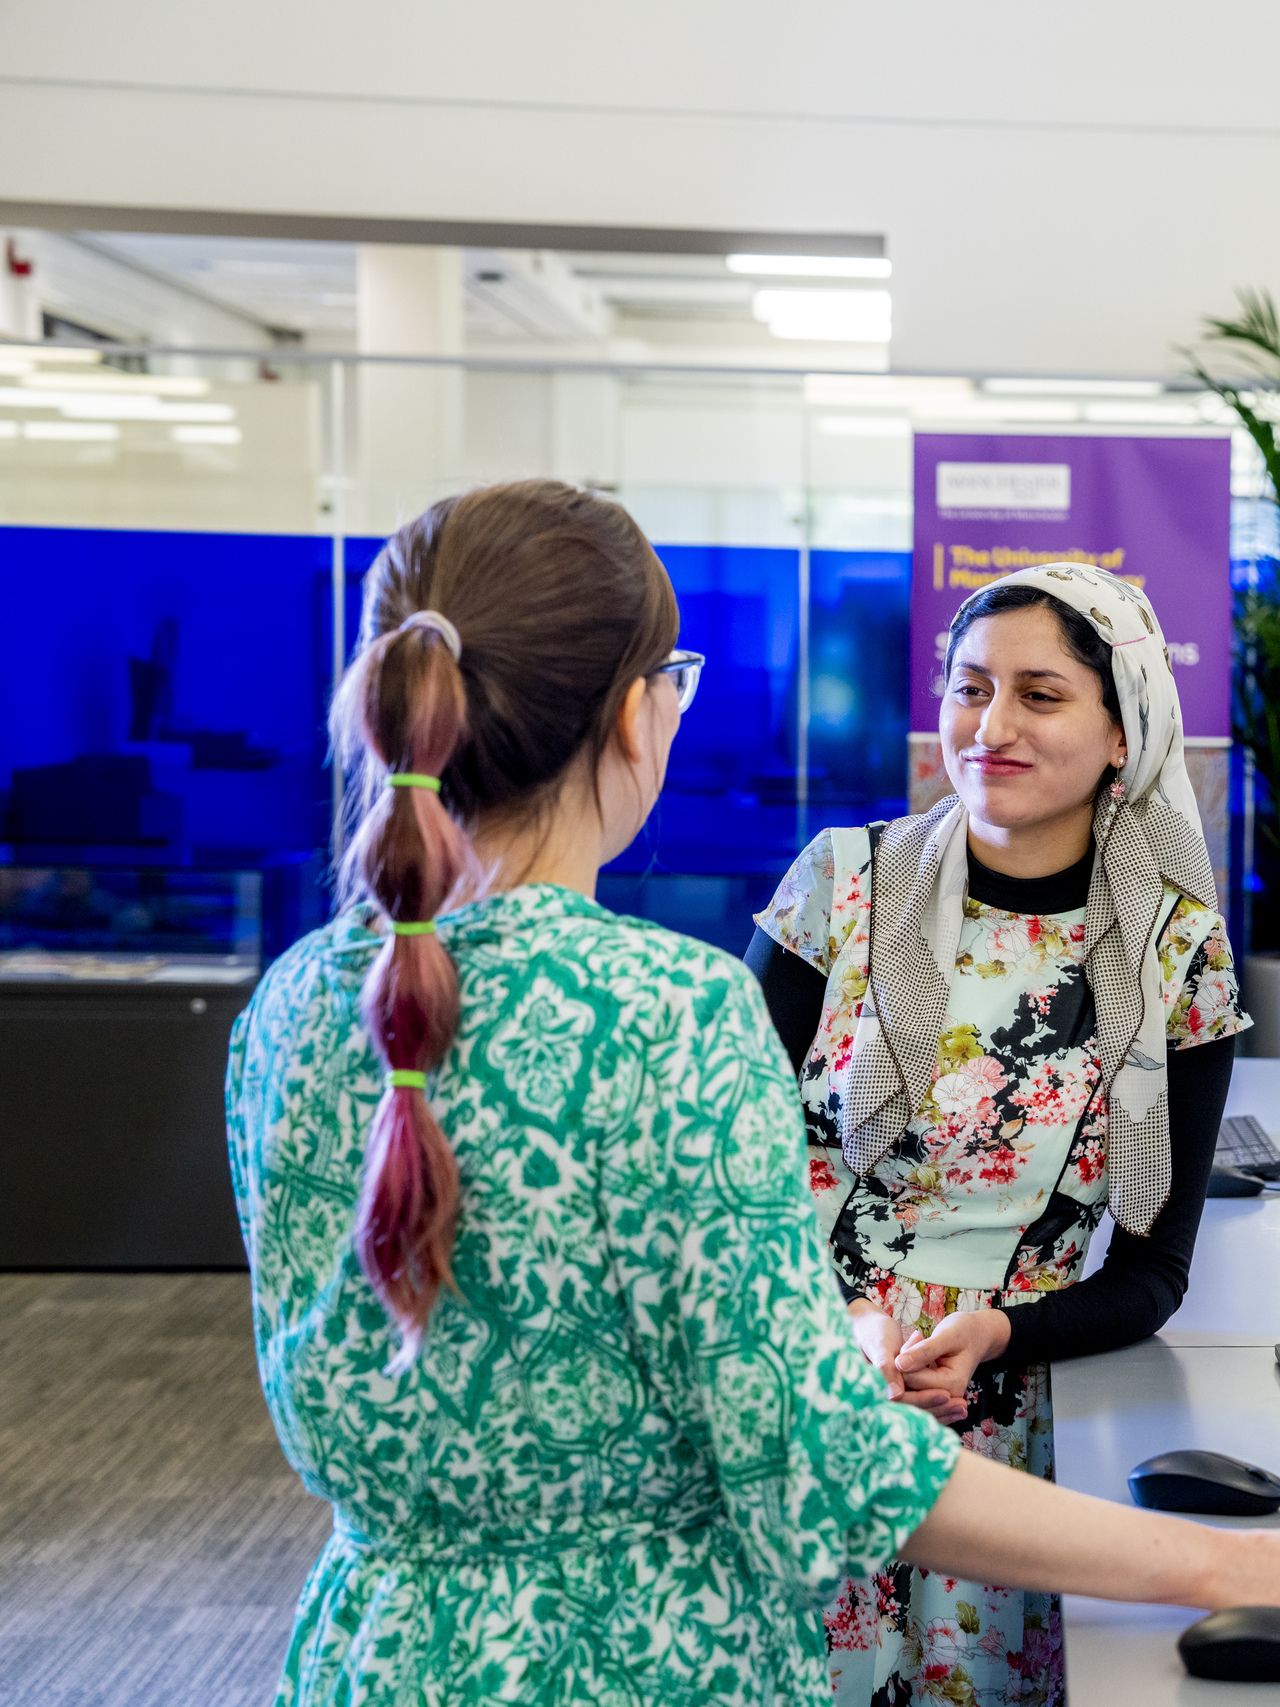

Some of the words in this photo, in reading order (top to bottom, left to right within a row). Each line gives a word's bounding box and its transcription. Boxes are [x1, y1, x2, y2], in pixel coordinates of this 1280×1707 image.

[950, 545, 989, 567] The
[992, 546, 1097, 568] University
[1098, 548, 1125, 569] of
